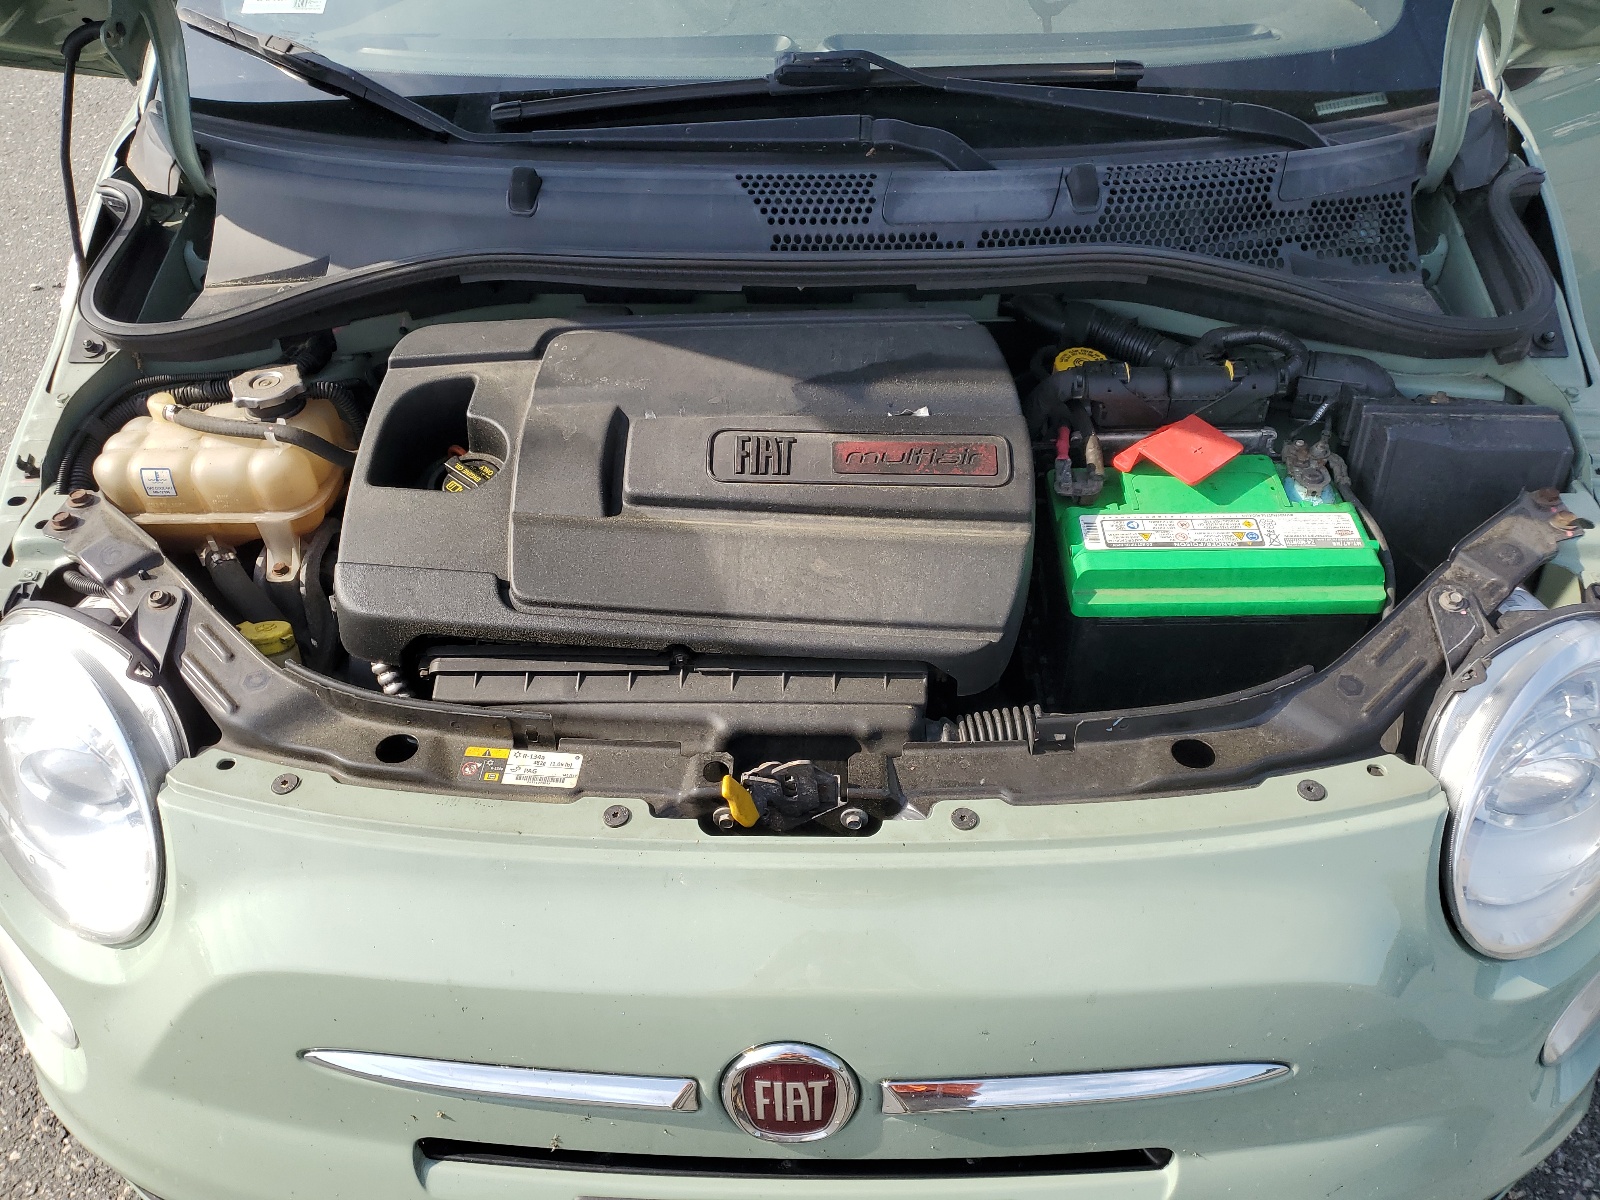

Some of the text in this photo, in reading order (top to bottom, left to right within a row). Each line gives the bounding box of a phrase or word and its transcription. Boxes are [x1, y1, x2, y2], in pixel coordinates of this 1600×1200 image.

[734, 435, 985, 476] FIAT multiair
[455, 462, 464, 471] OIL
[480, 465, 494, 476] ONLY
[462, 469, 481, 483] ENGINE
[754, 1080, 830, 1122] FIAT
